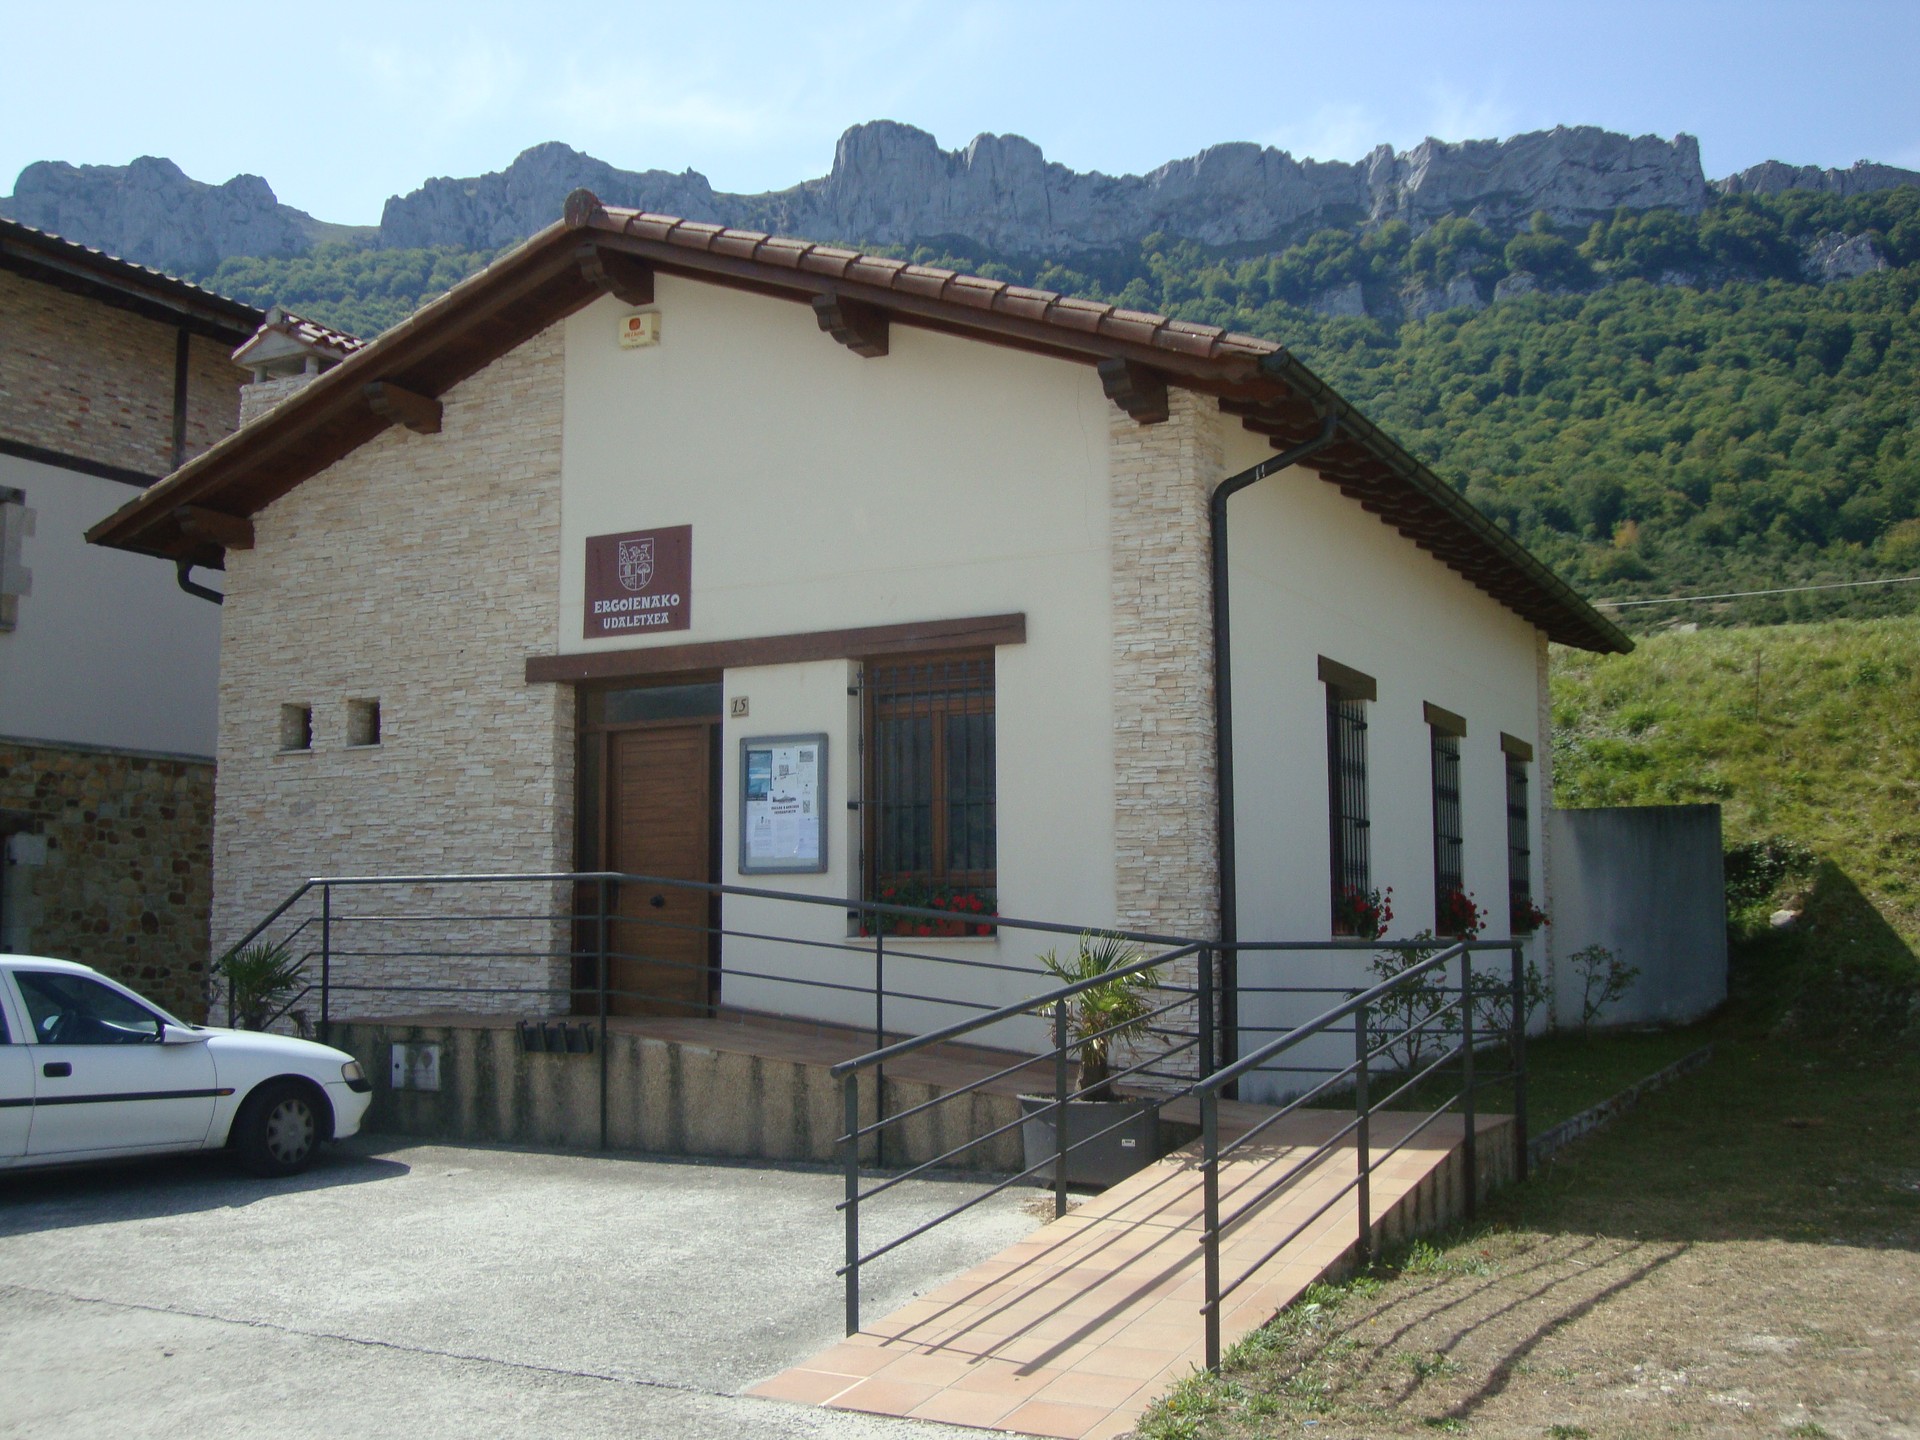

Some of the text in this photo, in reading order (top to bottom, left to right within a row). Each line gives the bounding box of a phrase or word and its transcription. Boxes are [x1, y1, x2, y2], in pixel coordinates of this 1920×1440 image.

[594, 594, 680, 613] ERGOIENAKO
[603, 612, 669, 629] UDALETXEA
[732, 698, 747, 713] 15
